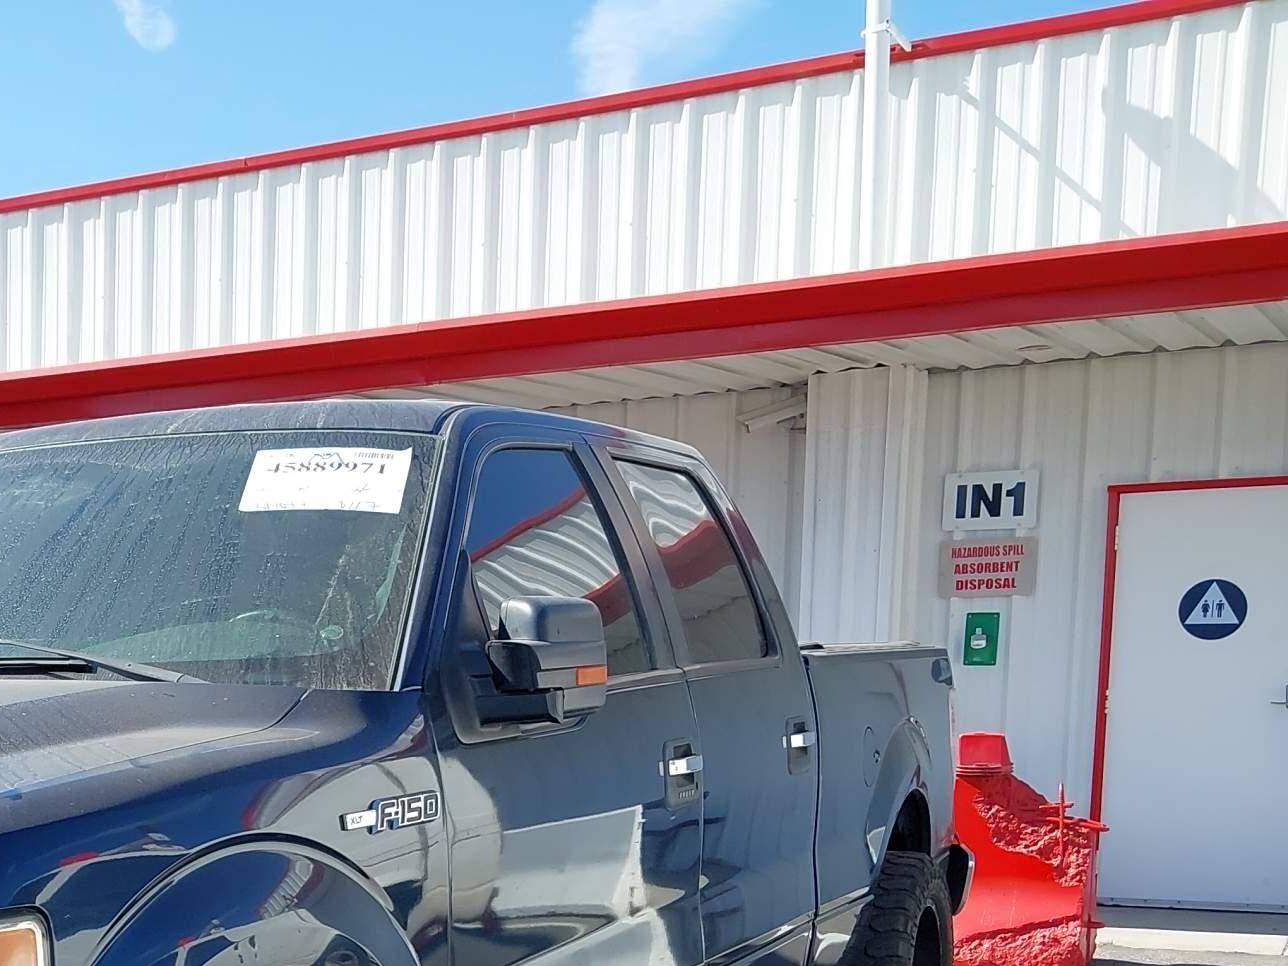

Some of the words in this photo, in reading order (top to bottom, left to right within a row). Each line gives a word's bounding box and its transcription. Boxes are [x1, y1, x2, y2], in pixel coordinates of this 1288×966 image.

[266, 461, 386, 475] 45889971
[955, 481, 1026, 519] IN1
[951, 545, 1001, 559] HAZARDOUS
[1002, 543, 1025, 556] SPILL
[954, 560, 1020, 575] ABSORBENT
[955, 577, 1017, 591] DISPOSAL
[378, 792, 441, 830] F-150
